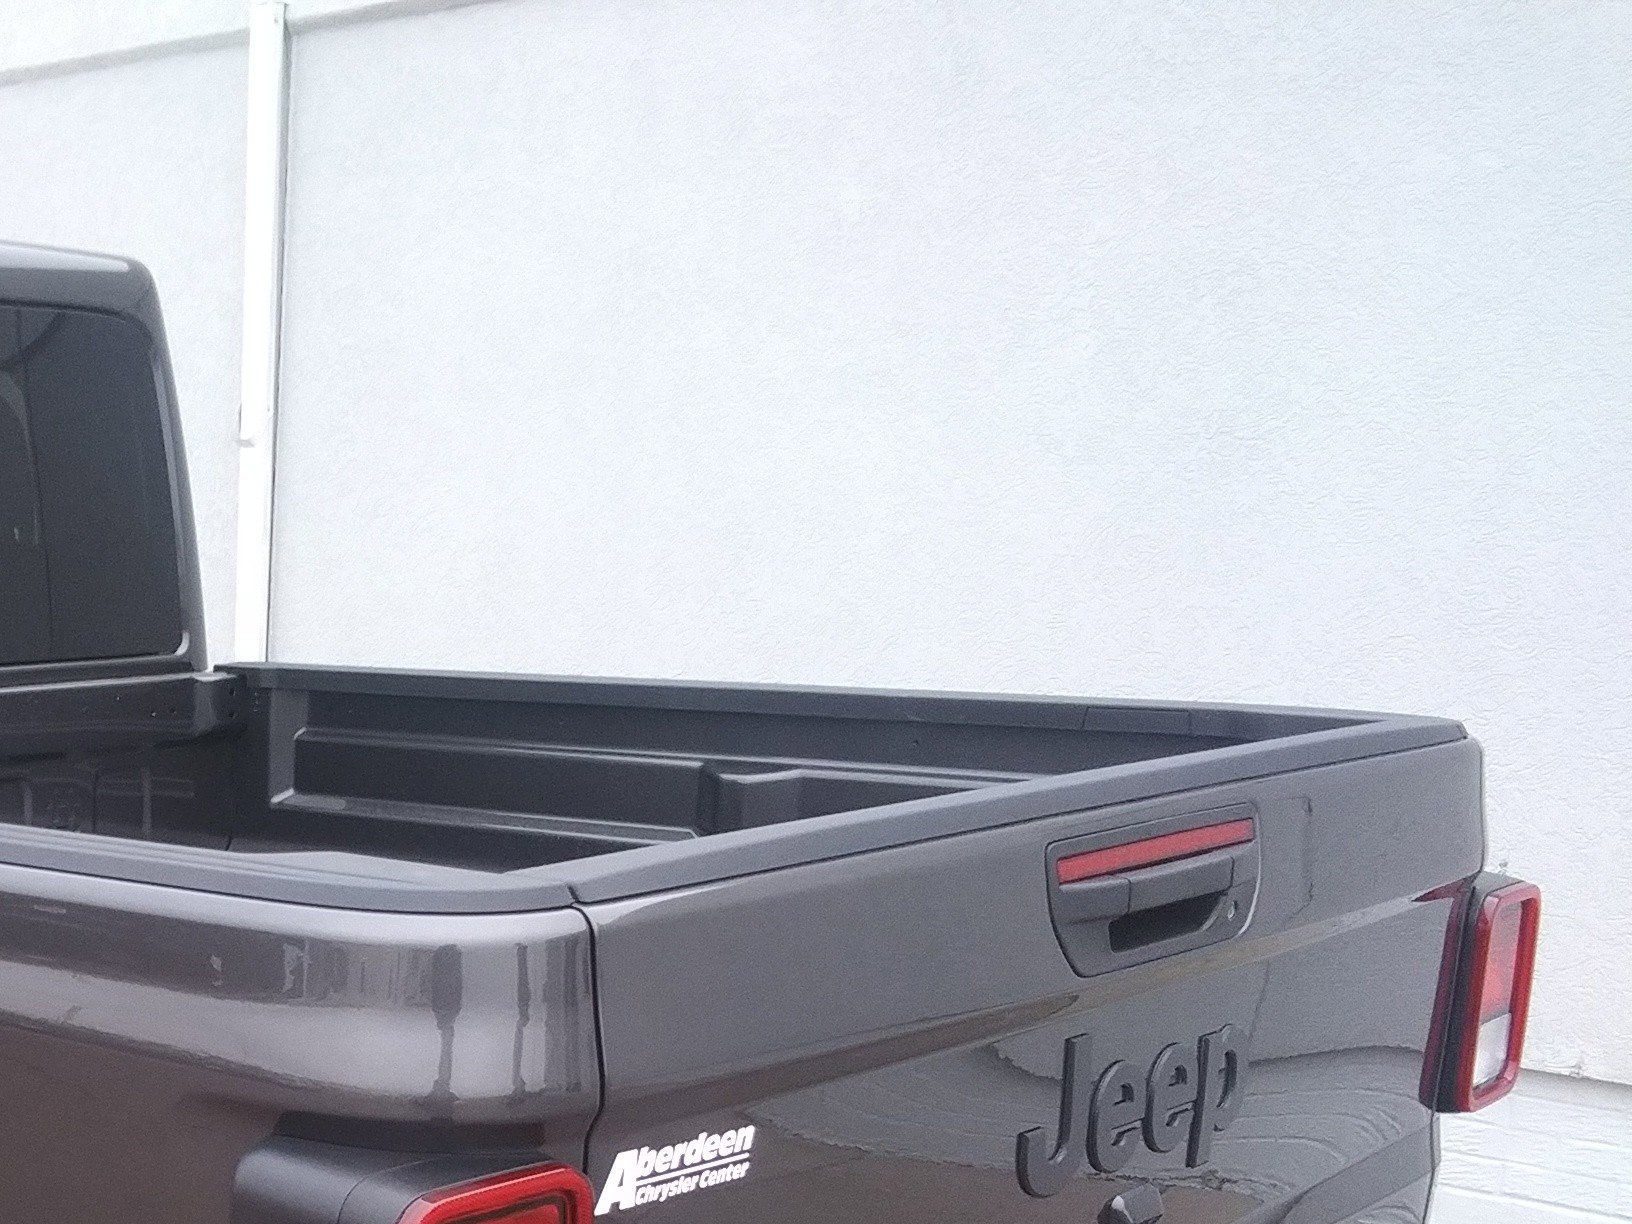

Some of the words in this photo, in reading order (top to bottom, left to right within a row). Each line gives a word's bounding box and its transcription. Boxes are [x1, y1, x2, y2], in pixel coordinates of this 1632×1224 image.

[1014, 1023, 1249, 1198] Jeep
[593, 1124, 756, 1217] Aberdeen
[635, 1174, 699, 1206] Chrysler
[699, 1161, 750, 1189] Center
